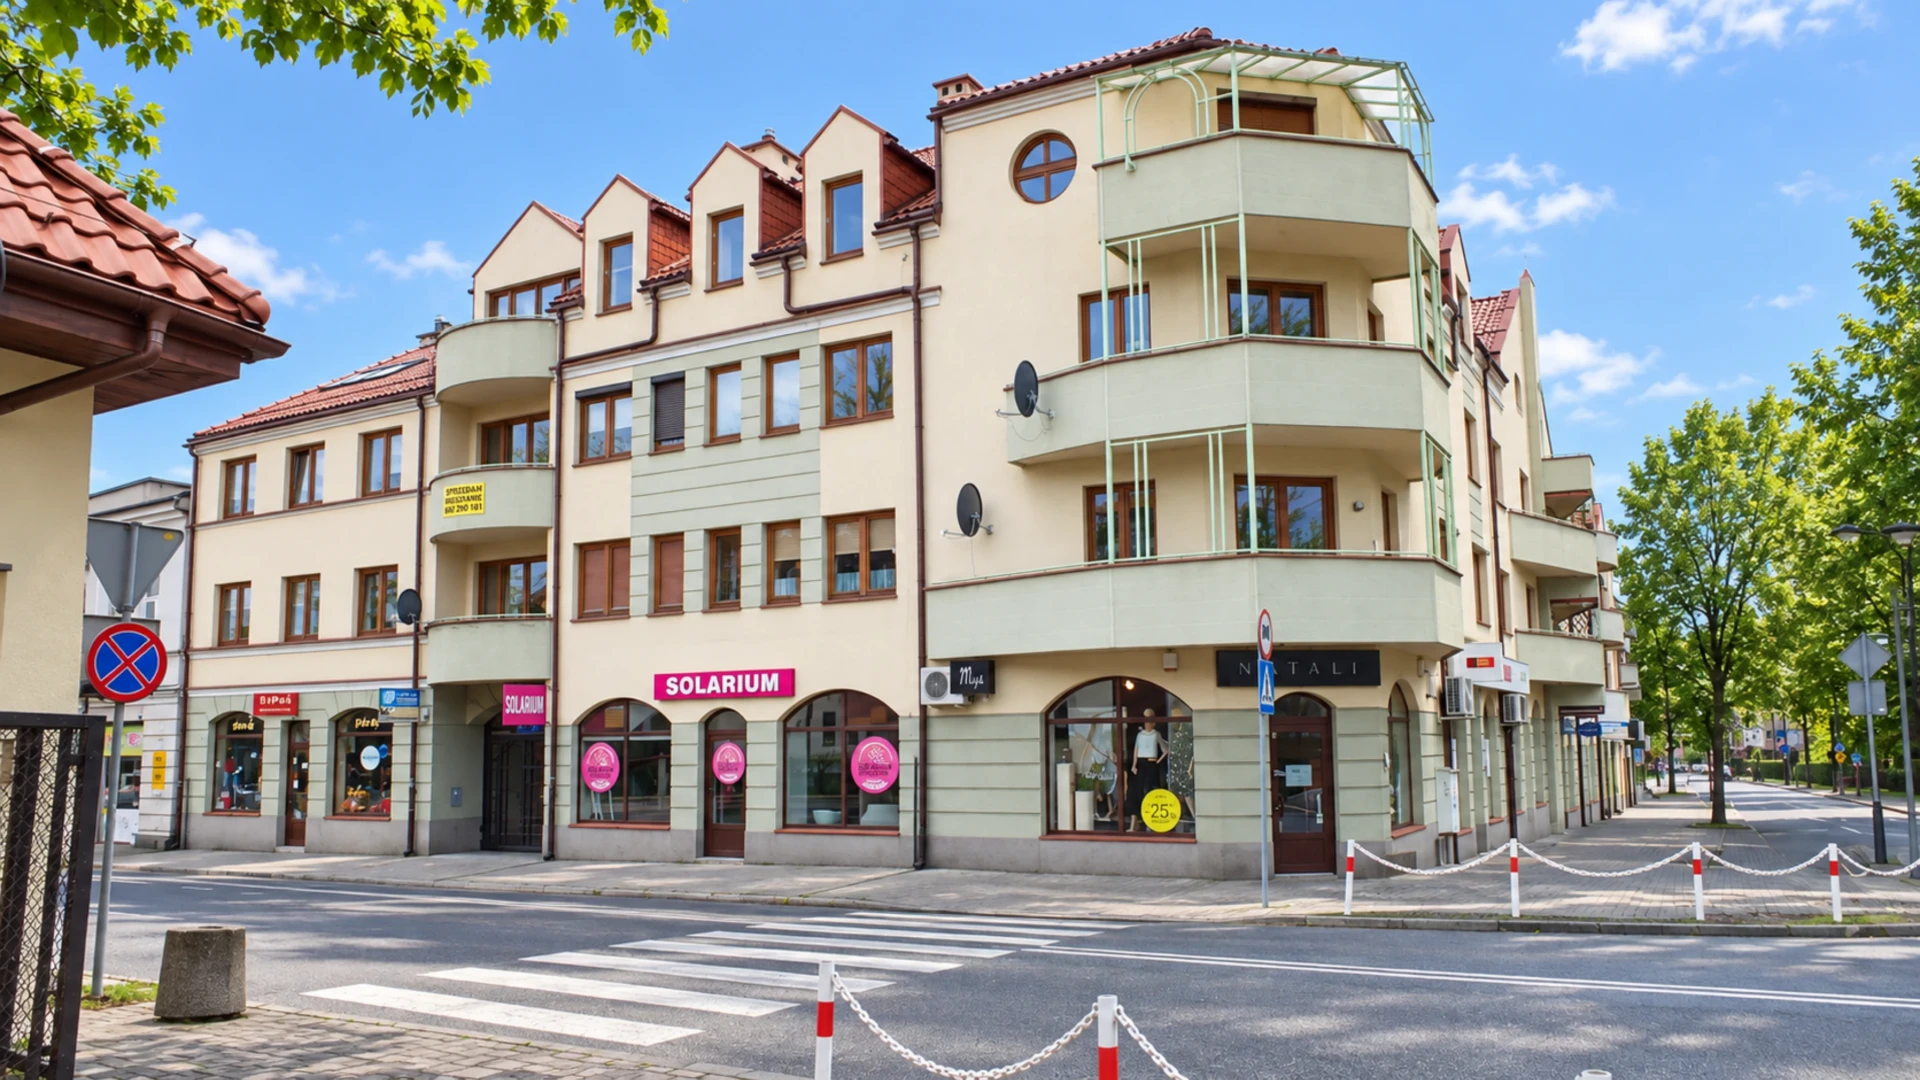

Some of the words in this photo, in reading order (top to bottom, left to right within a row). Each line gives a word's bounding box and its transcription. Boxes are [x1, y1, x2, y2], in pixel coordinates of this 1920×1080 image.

[1239, 662, 1356, 675] NTALI
[666, 673, 779, 696] SOLARIUM
[505, 695, 544, 714] SOLARIUM
[1151, 803, 1169, 819] 25
